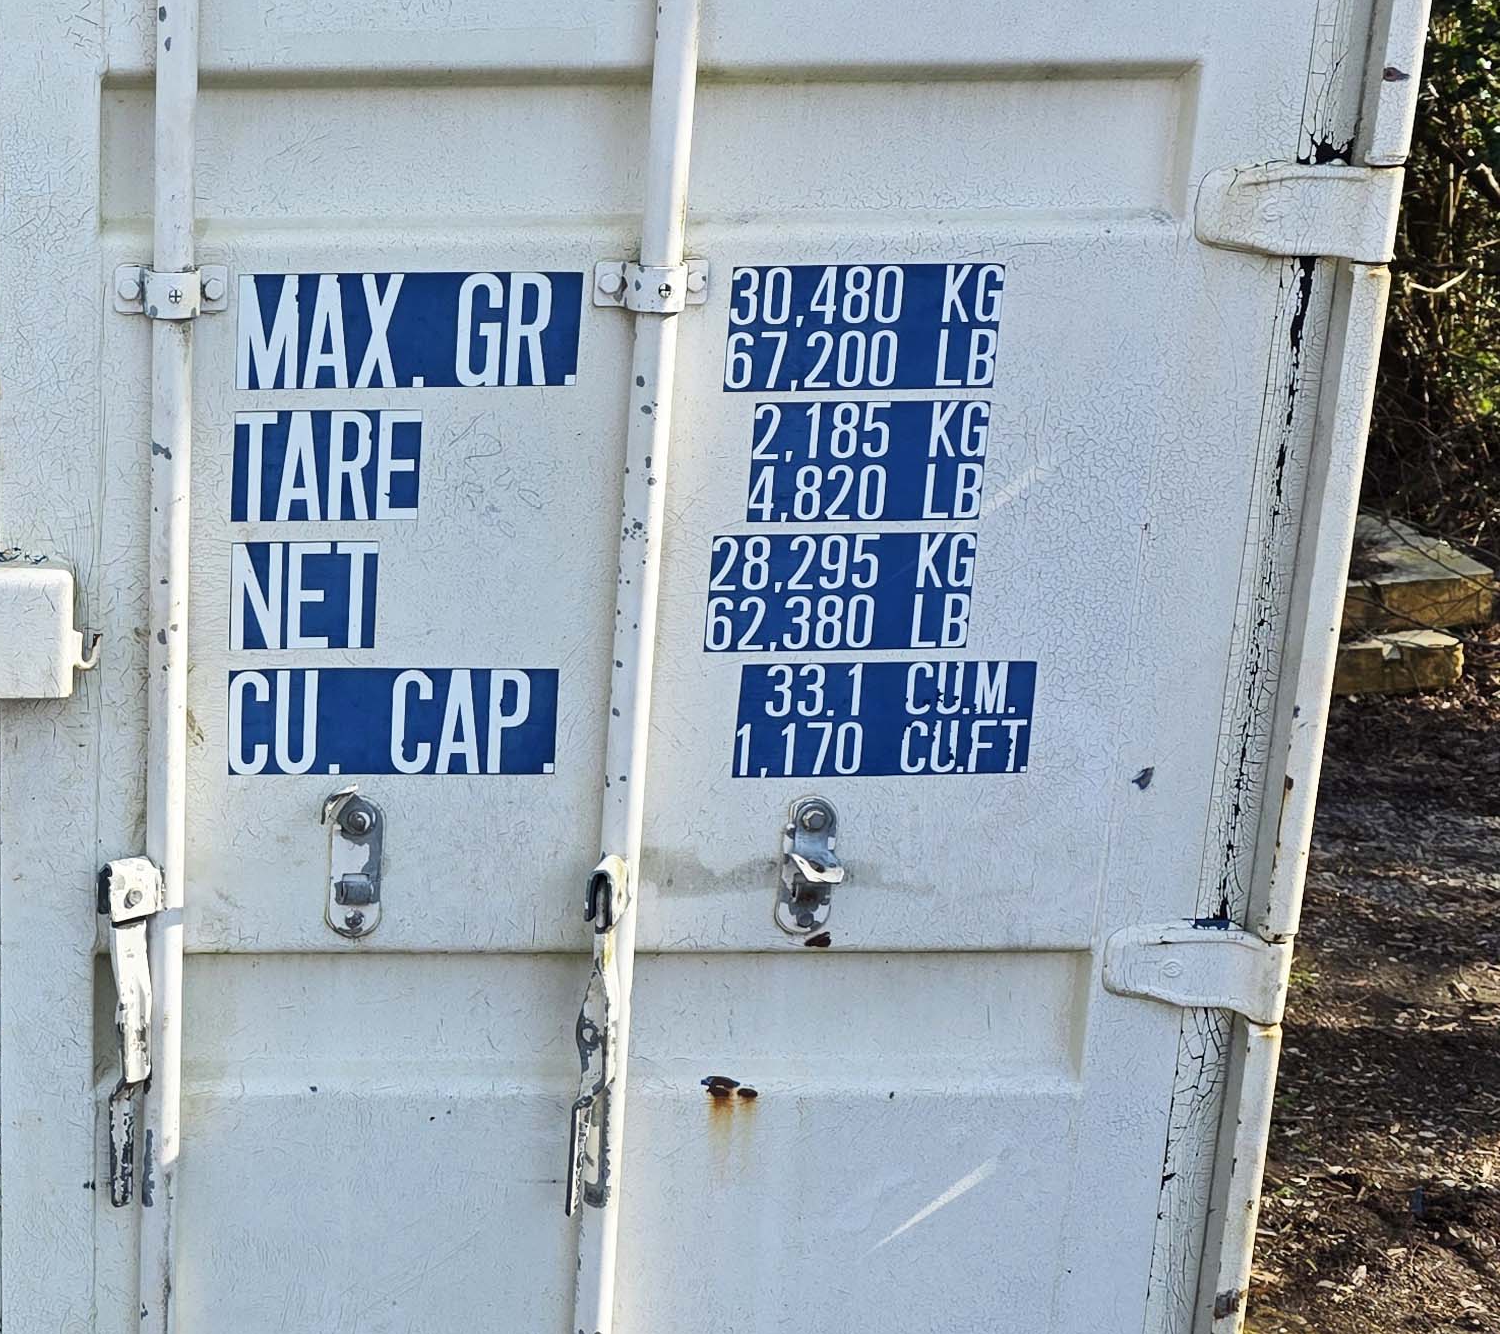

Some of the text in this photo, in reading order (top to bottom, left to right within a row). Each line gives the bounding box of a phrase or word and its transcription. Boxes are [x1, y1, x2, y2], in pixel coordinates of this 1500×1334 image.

[729, 264, 1004, 328] 30,480 KG
[236, 272, 576, 389] MAX. GR.
[725, 328, 998, 391] 67,200 LB
[752, 401, 991, 463] 2,185 KG
[235, 410, 422, 521] TARE
[748, 463, 984, 522] 4,820 LB
[708, 533, 977, 593] 28,295 KG
[231, 542, 380, 649] NET
[705, 593, 971, 652] 62,380 LB
[764, 663, 864, 718] 33.1
[229, 669, 555, 775] CU. CAP.
[736, 721, 863, 778] 1,170
